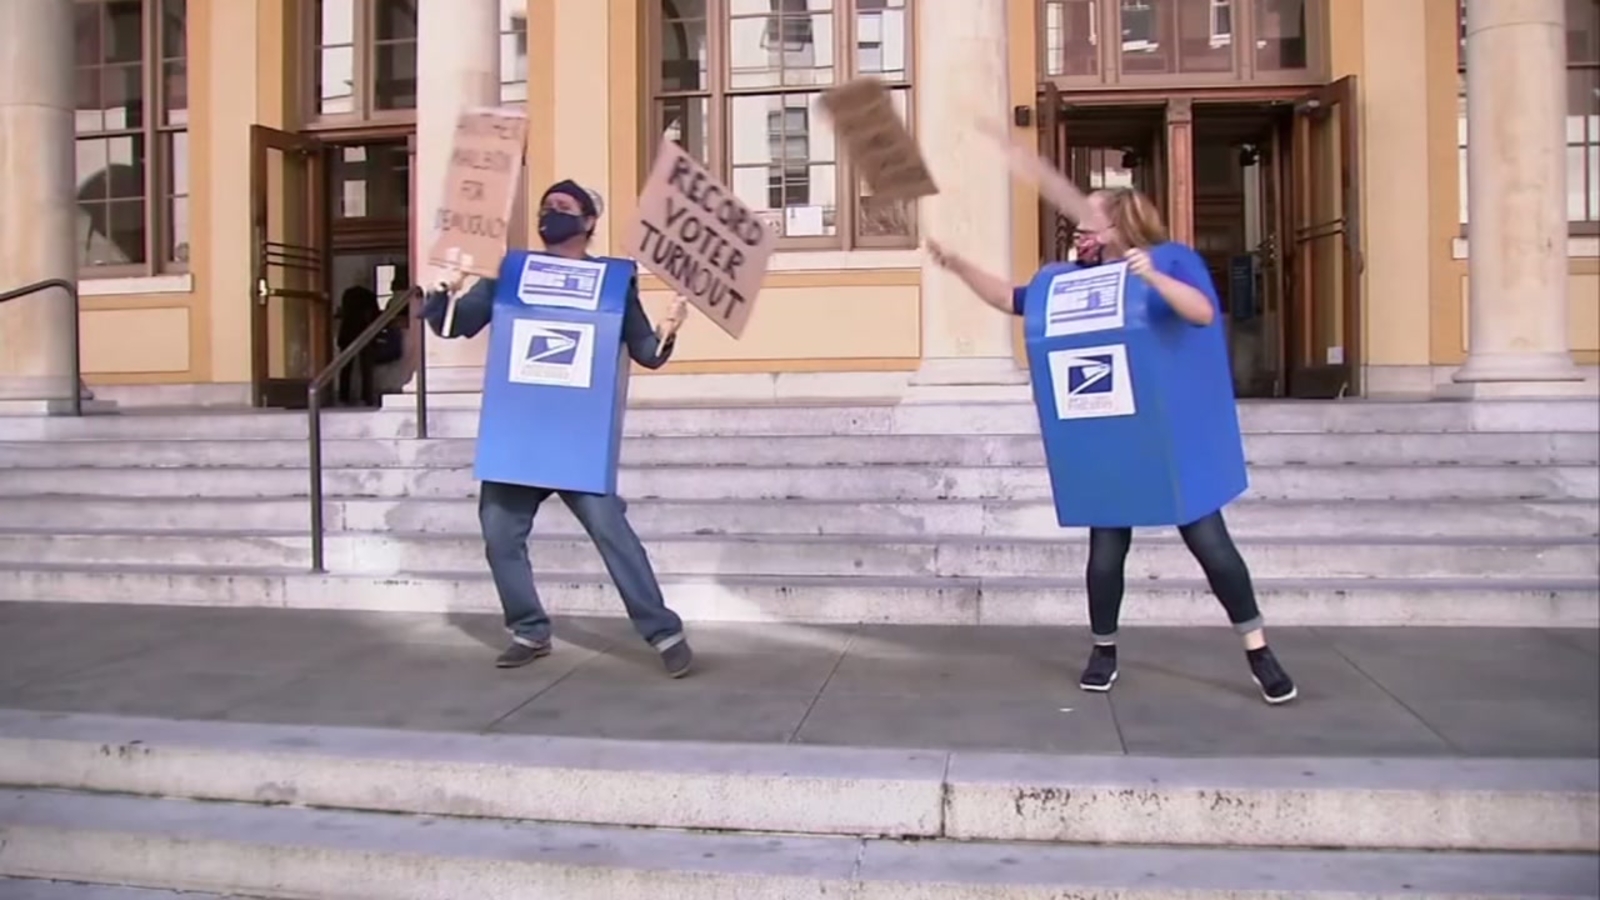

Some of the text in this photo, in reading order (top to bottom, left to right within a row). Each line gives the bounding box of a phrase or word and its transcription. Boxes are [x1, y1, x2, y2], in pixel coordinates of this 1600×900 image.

[667, 155, 763, 247] RECORD
[667, 197, 745, 281] VOTER
[639, 219, 745, 320] TURNOUT
